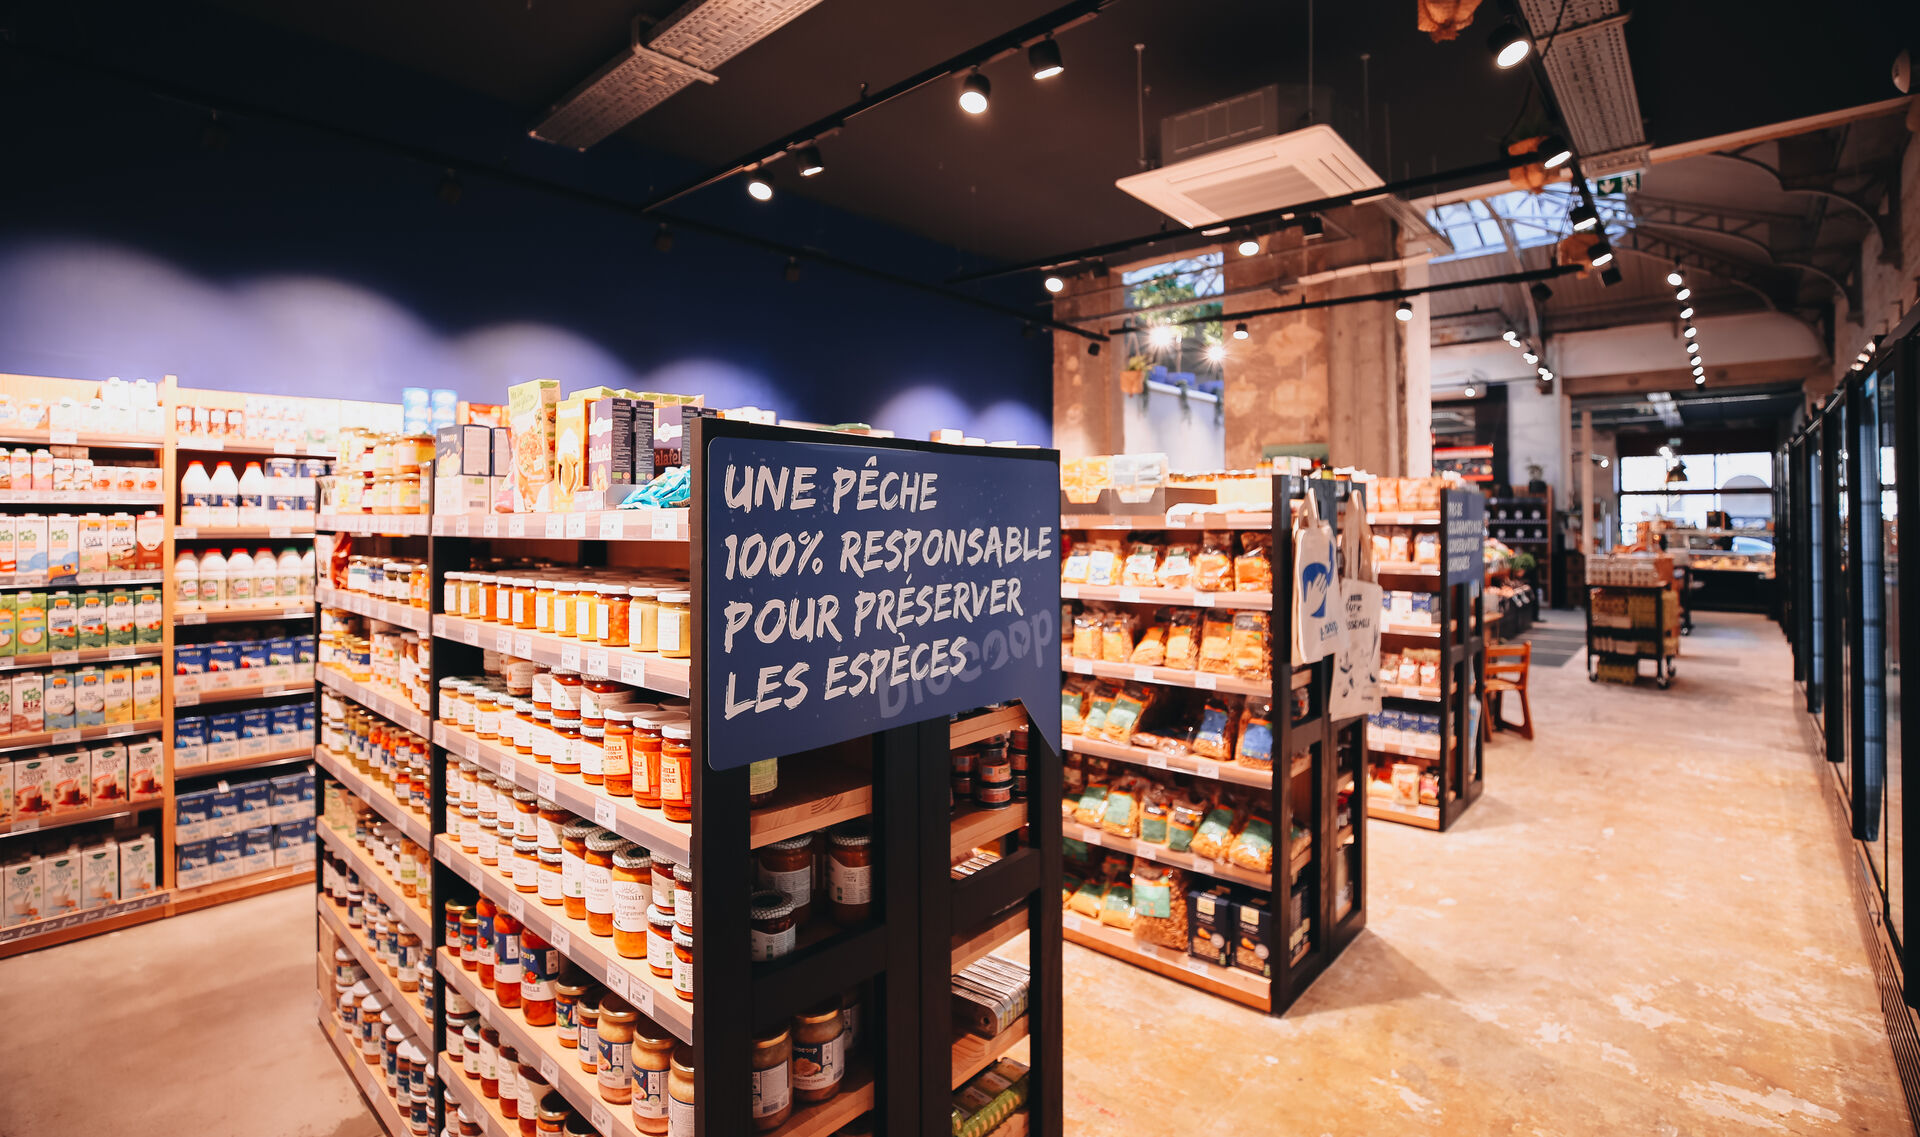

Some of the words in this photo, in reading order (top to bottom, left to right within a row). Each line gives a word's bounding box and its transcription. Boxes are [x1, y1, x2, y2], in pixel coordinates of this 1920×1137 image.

[724, 463, 818, 514] UNE
[832, 455, 938, 514] PÊCHE
[724, 529, 824, 581] 100%
[839, 526, 1052, 579] RESPONSABLE
[723, 594, 843, 654] POUR
[854, 573, 1025, 638] PRÉSERVER
[724, 661, 811, 721] LES
[824, 632, 969, 701] ESPÈCES
